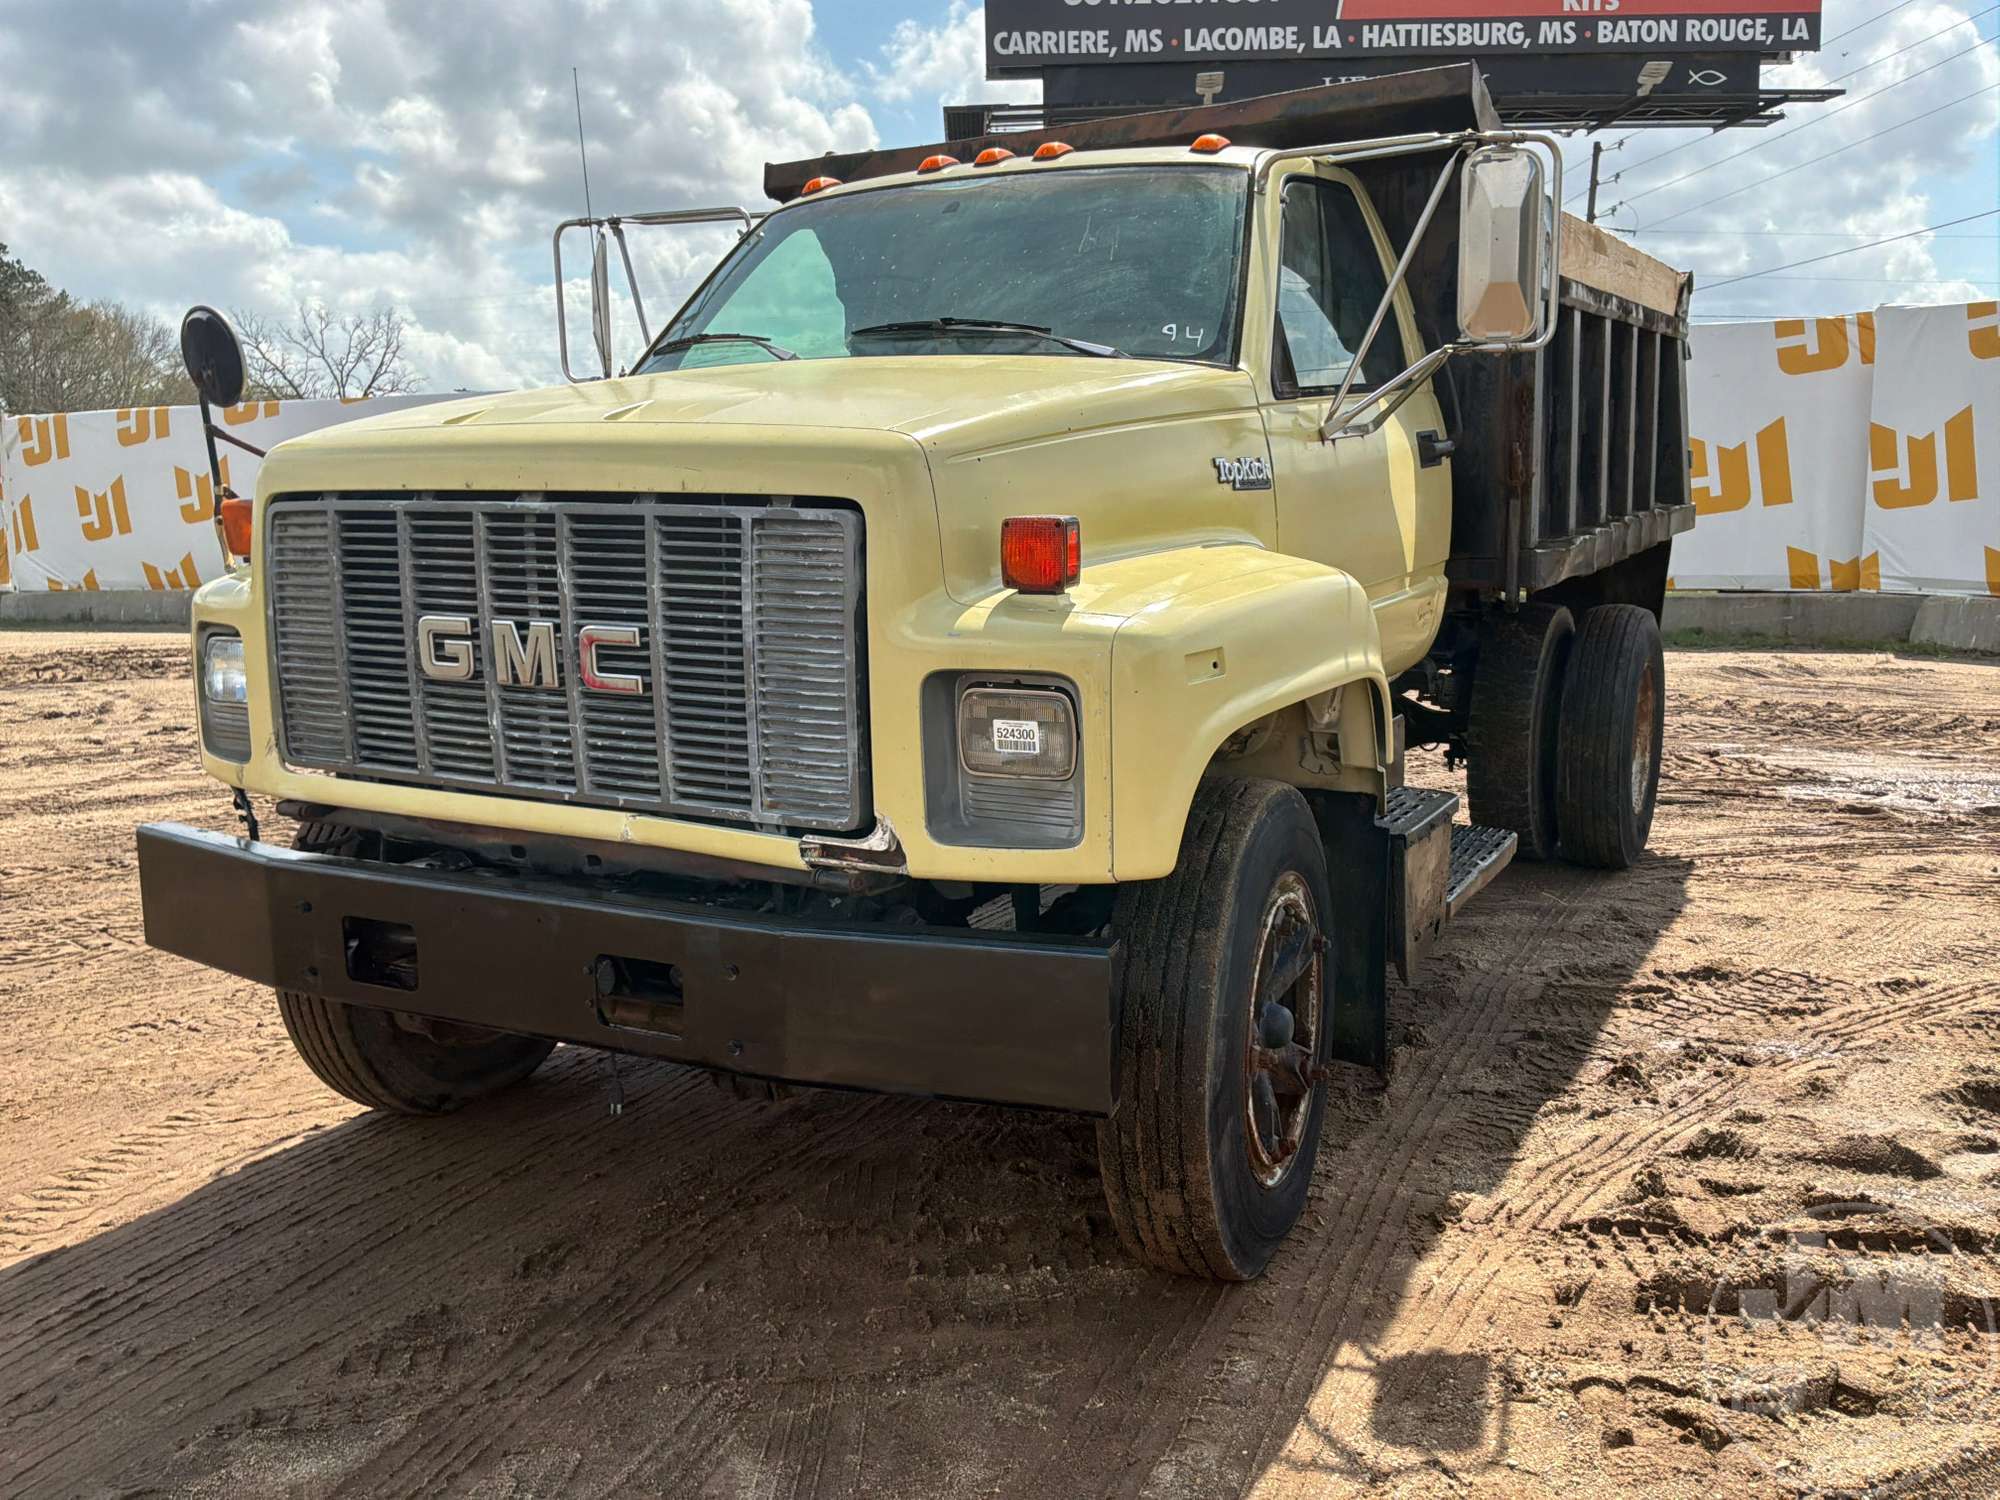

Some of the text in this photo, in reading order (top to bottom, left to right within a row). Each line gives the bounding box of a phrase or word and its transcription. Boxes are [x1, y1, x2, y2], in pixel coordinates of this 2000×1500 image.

[993, 17, 1810, 58] CARRIERE, MS LACOMBE, LA HATTIESBURG, MS BATON ROUGE, LA
[418, 615, 643, 695] GMC
[996, 727, 1036, 741] 524300
